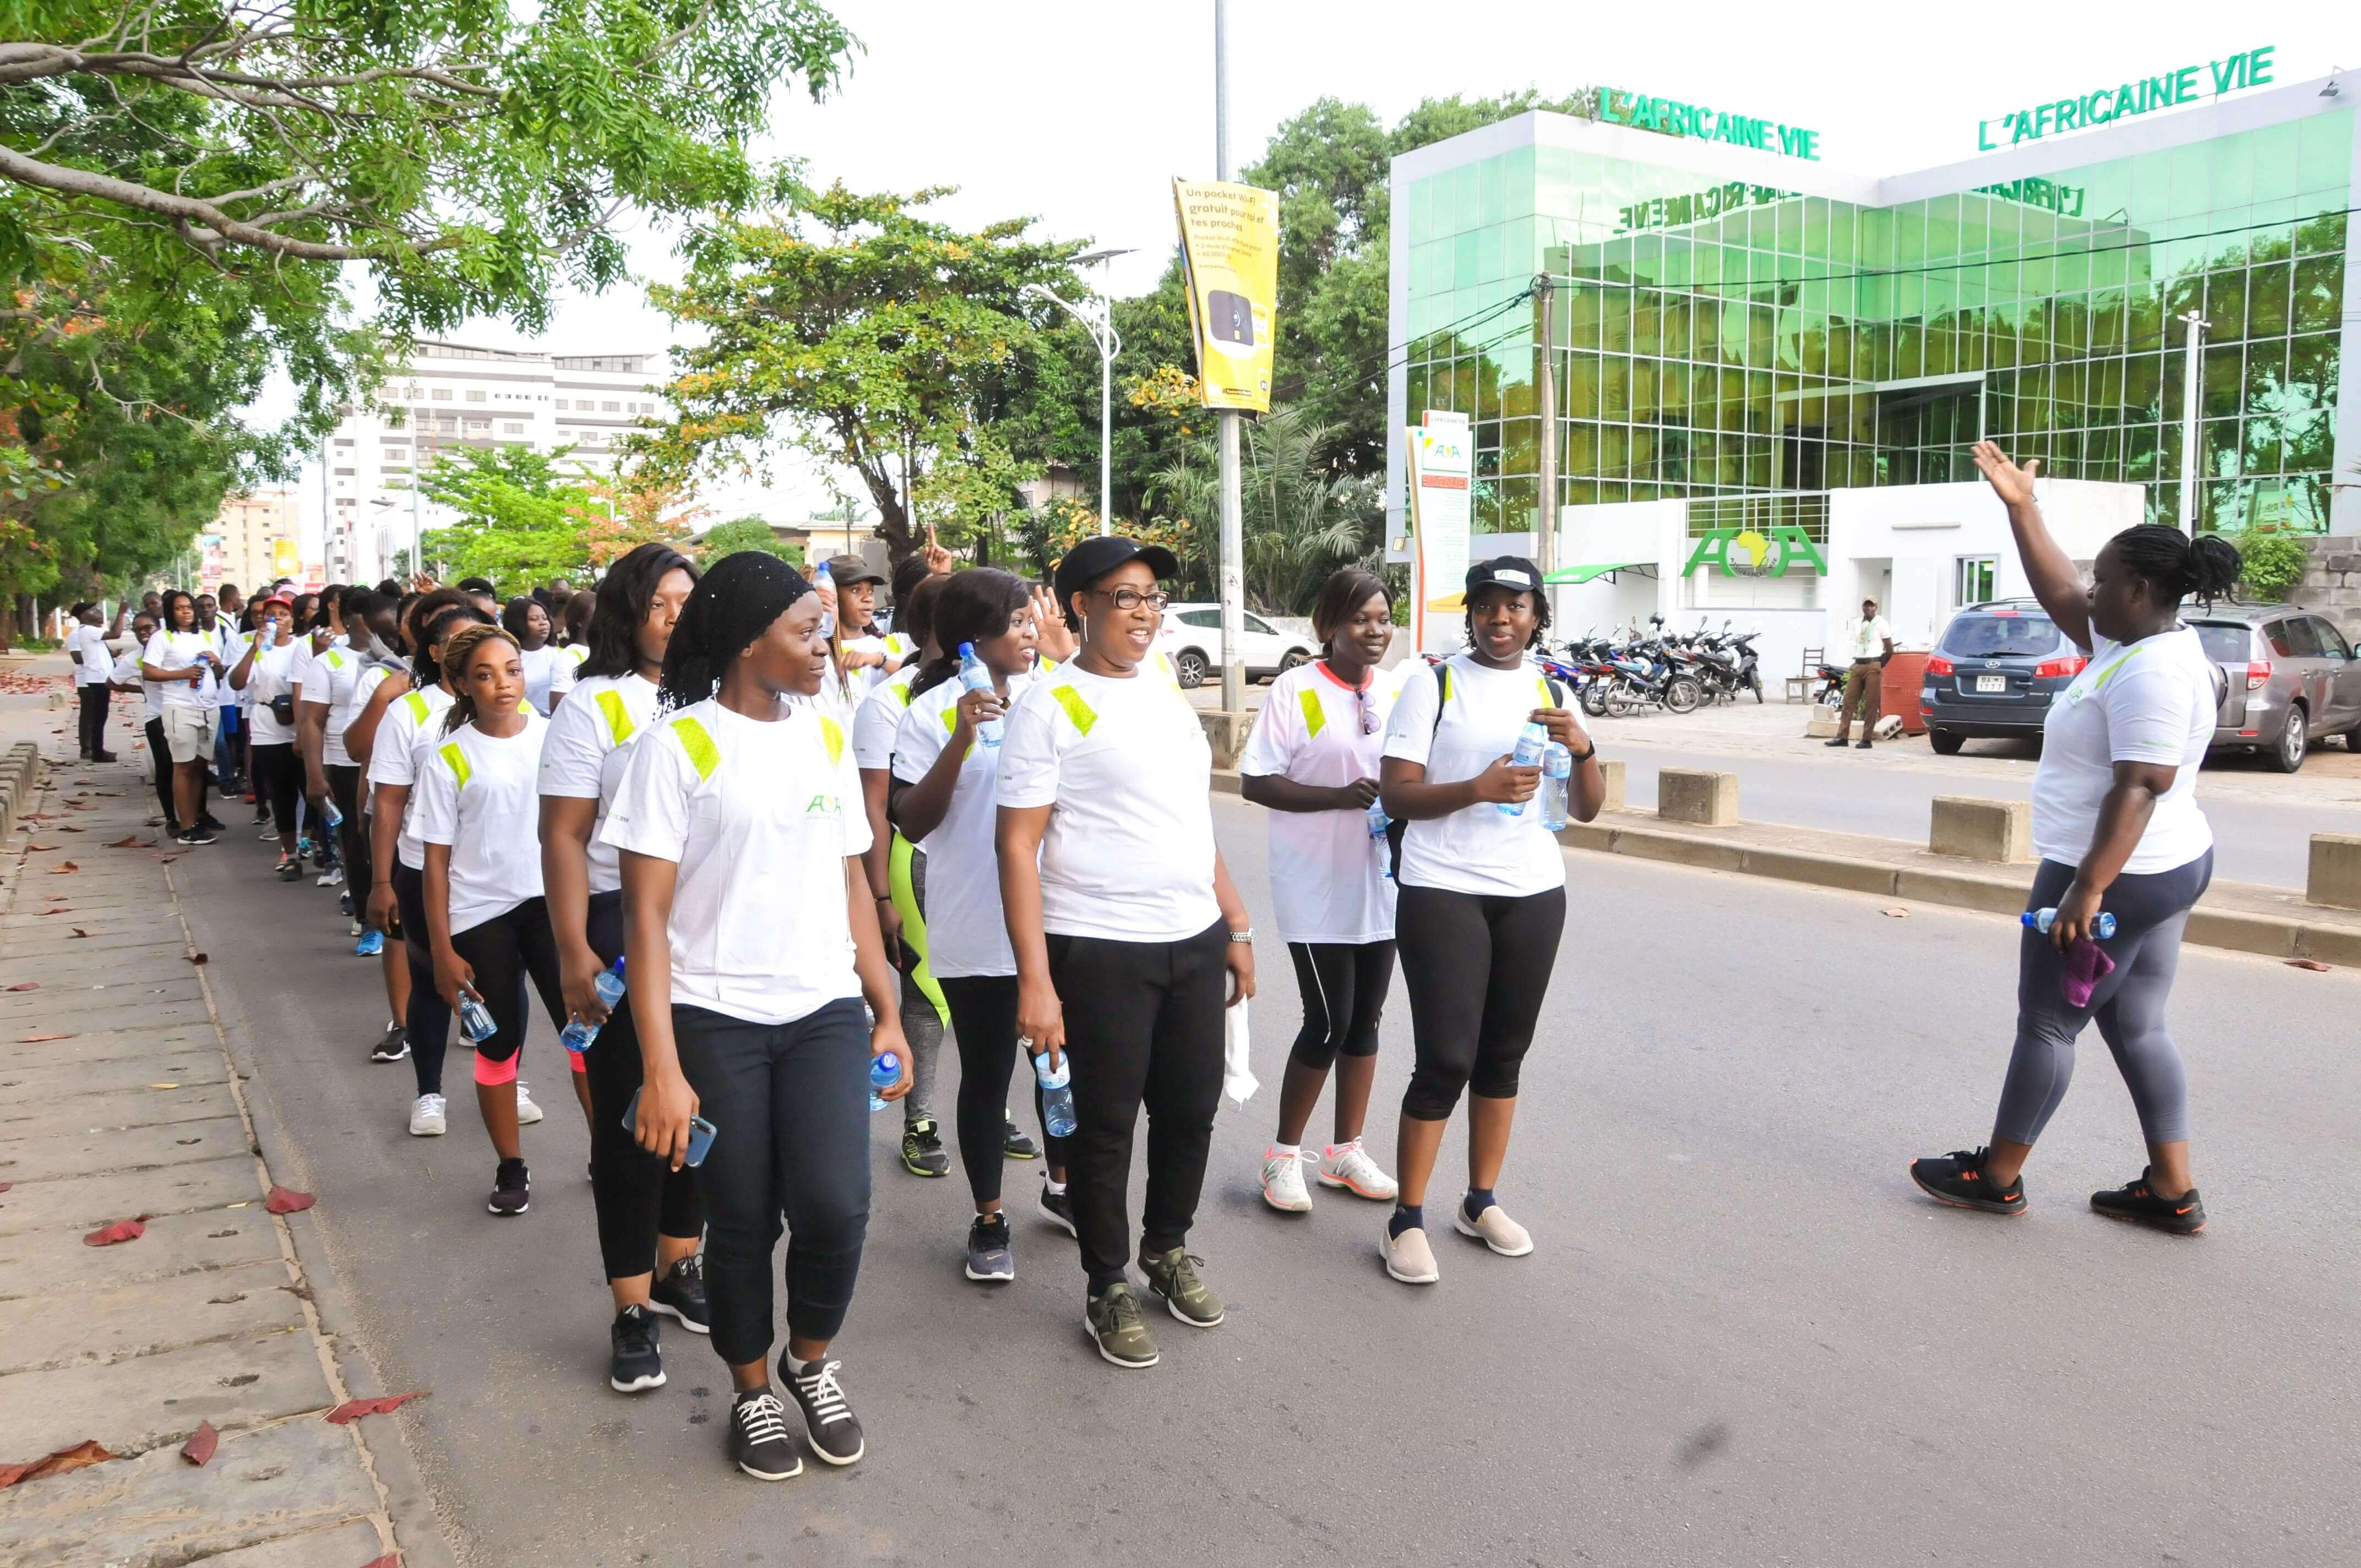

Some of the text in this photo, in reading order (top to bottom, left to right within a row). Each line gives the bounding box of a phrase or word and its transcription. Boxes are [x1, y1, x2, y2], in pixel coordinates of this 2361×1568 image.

[1978, 46, 2276, 151] L'AFRICAINE VIE
[1600, 86, 1820, 161] L'AFRICAINE VIE
[1186, 189, 1201, 197] Un
[1204, 190, 1236, 200] pocket
[1189, 203, 1228, 215] gratuit
[1231, 208, 1246, 219] pour
[1256, 216, 1264, 225] et
[1191, 218, 1243, 231] tes proches
